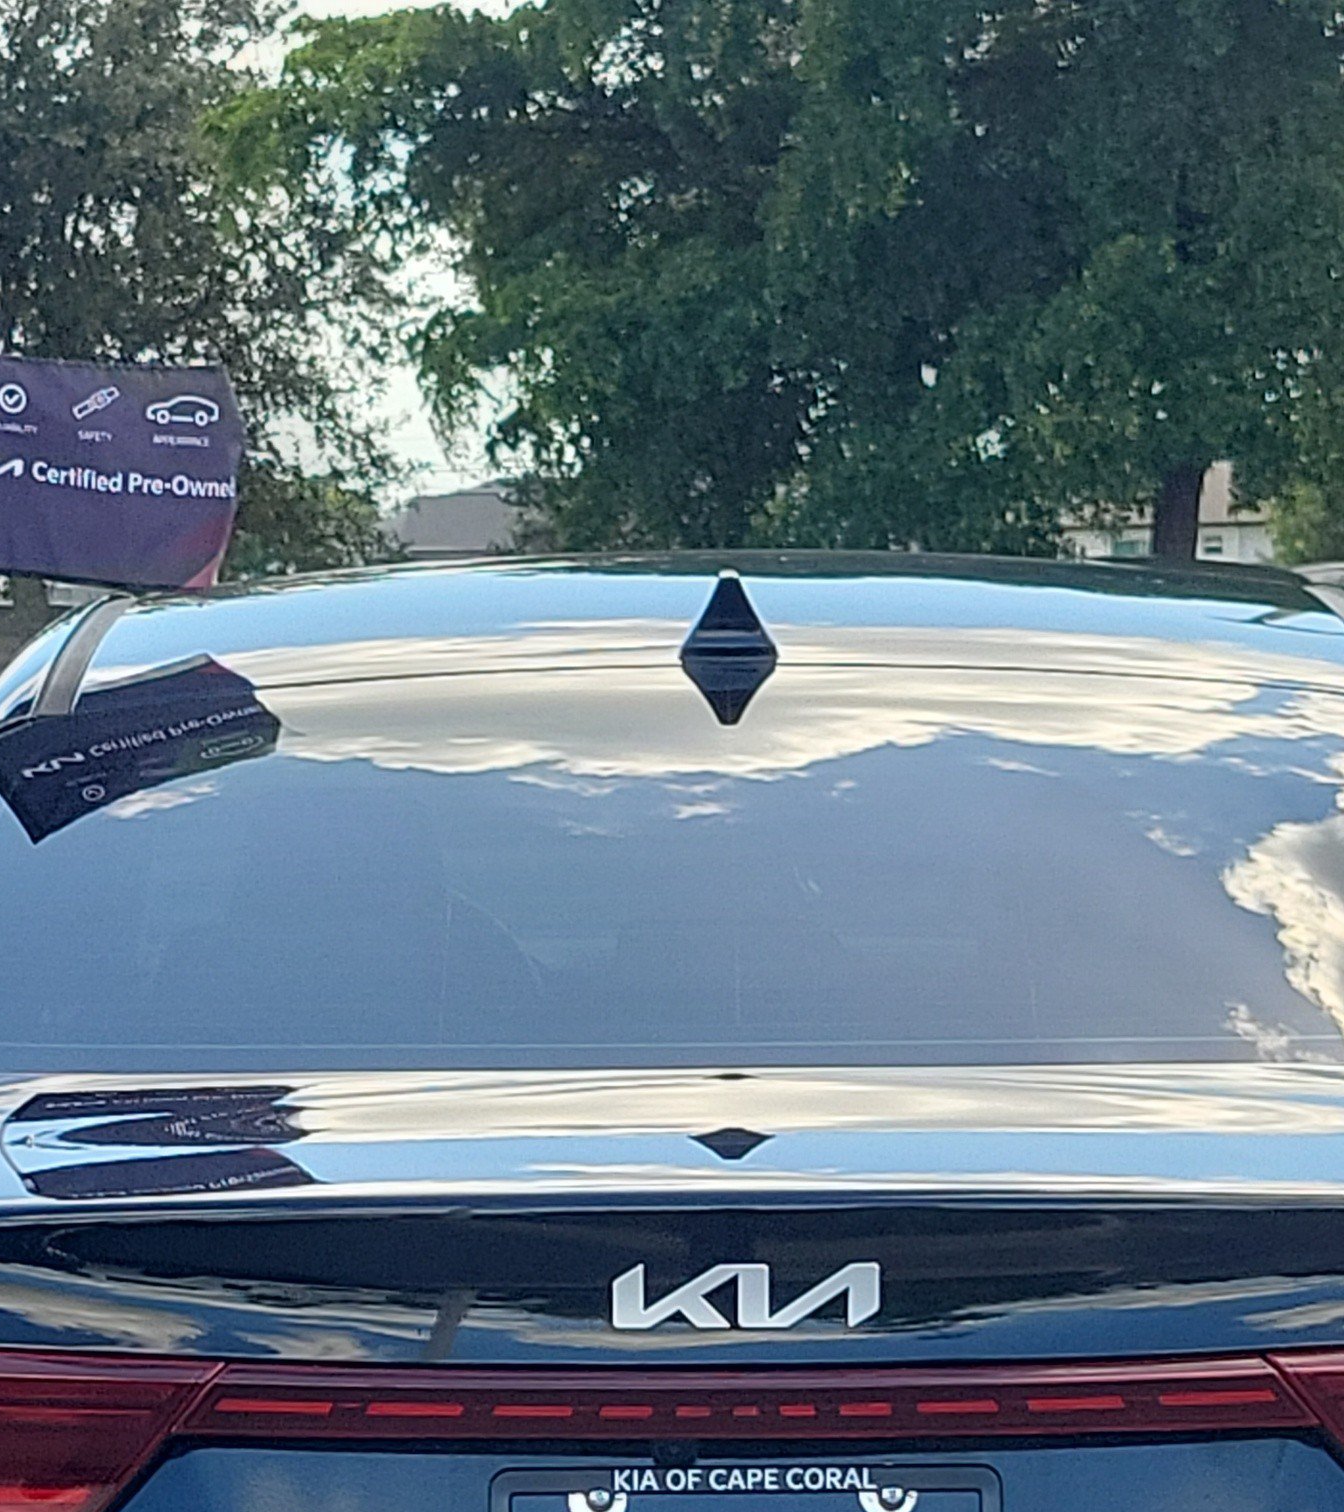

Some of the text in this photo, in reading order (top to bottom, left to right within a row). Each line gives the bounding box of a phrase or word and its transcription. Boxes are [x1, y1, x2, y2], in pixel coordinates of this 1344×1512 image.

[31, 460, 123, 494] Certified
[611, 1261, 881, 1329] KIA
[613, 1466, 878, 1492] KIA OF CAPE CORAL
